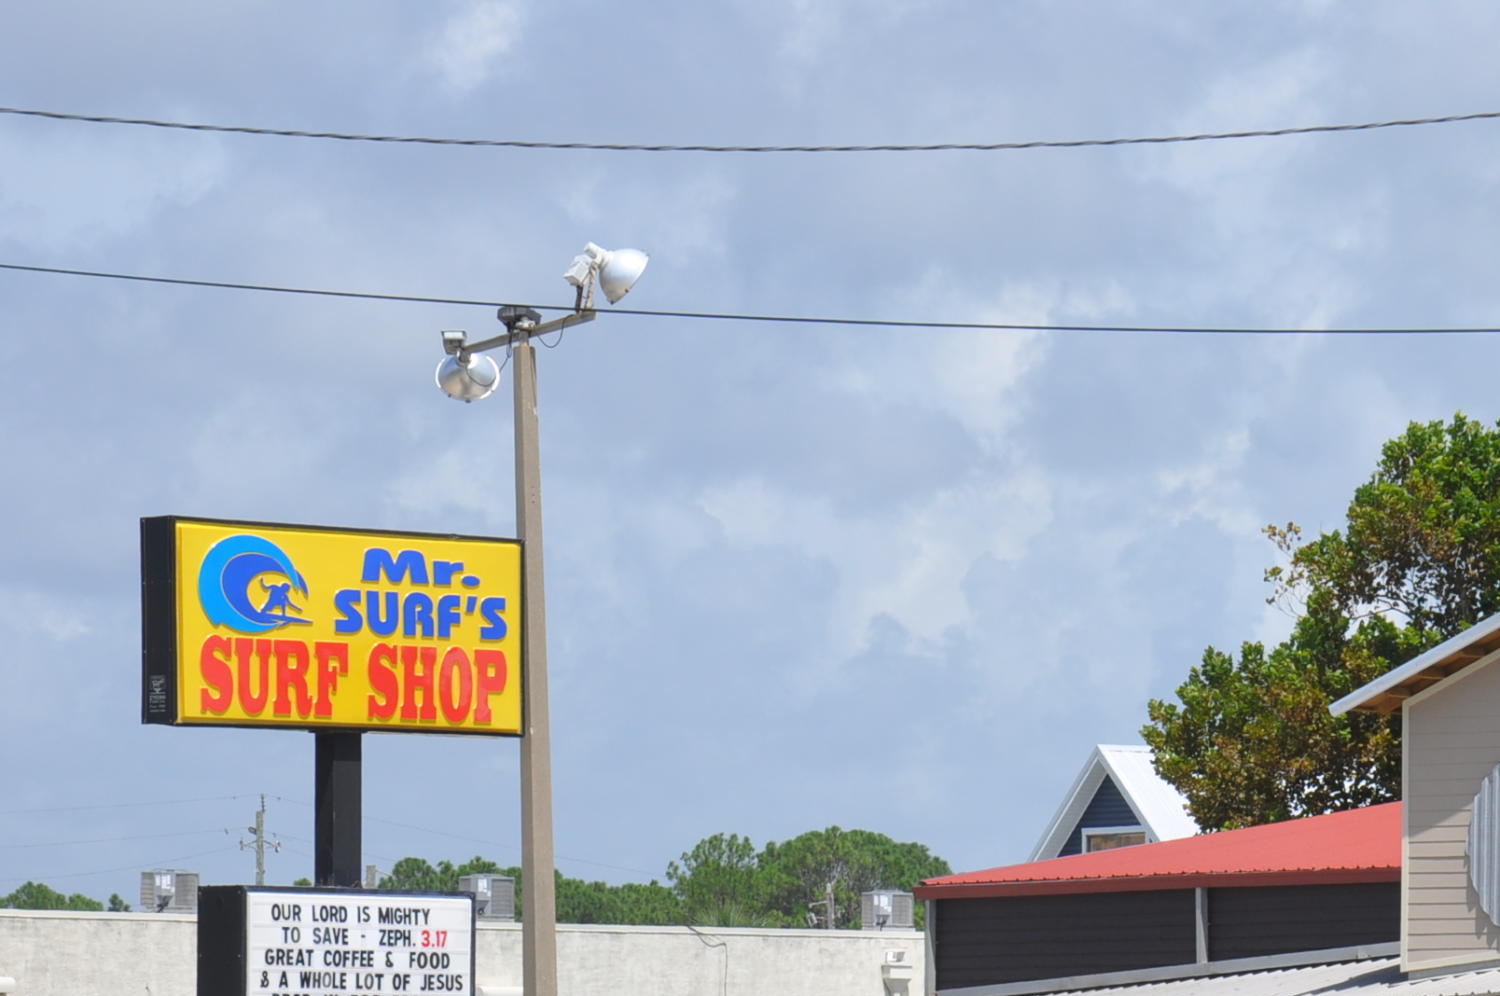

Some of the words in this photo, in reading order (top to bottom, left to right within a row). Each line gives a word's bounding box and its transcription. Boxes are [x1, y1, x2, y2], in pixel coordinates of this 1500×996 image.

[361, 548, 480, 588] Mr.
[334, 588, 508, 641] SURF'S
[200, 634, 349, 718] SURF
[367, 642, 508, 724] SHOP
[271, 904, 301, 922] OUR
[312, 905, 347, 923] LORD
[357, 906, 371, 923] IS
[378, 907, 430, 925] MIGHTY
[282, 927, 301, 943] TO
[313, 928, 349, 945] SAVE
[379, 929, 416, 947] ZEPH.
[421, 930, 448, 947] 3.17
[265, 949, 313, 966] GREAT
[323, 950, 374, 967] COFFEE
[385, 952, 394, 967] &
[409, 952, 450, 969] FOOD
[279, 972, 288, 988] A
[300, 972, 347, 989] WHOLE
[356, 973, 384, 990] LOT
[392, 973, 410, 990] OF
[420, 974, 463, 991] JESUS
